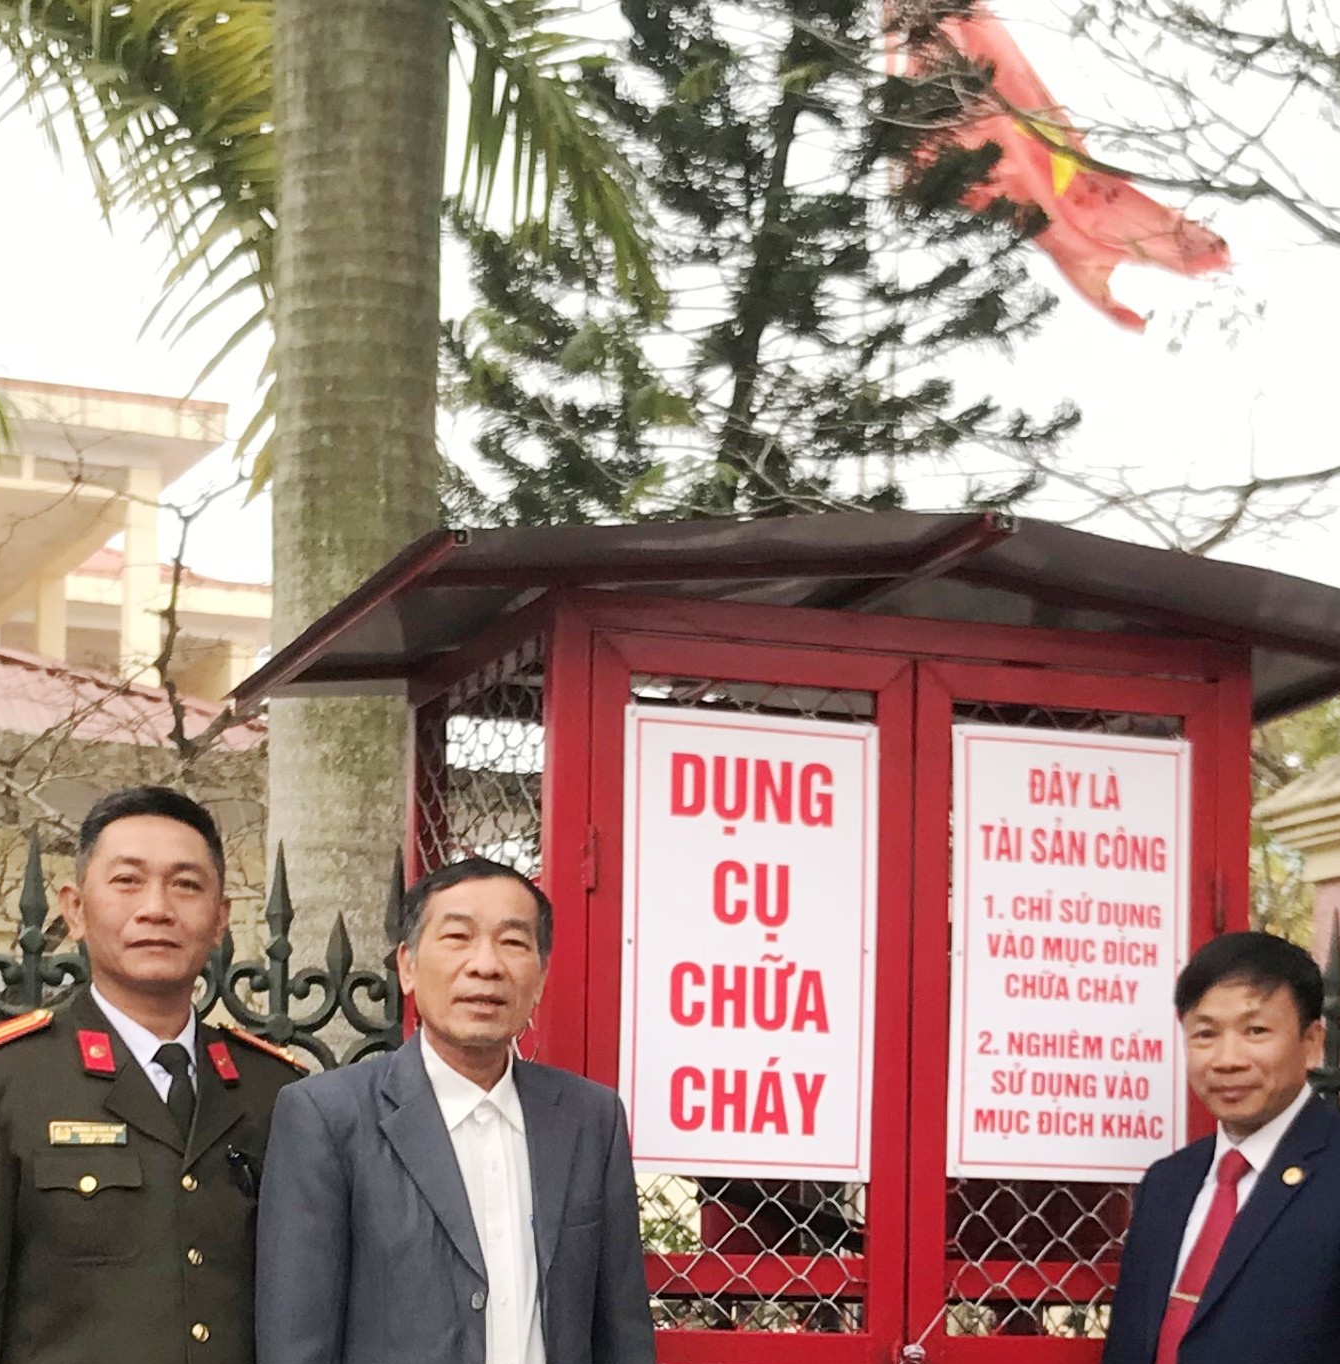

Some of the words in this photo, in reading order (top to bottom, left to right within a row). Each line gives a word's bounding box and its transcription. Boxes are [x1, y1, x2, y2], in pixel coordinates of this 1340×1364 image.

[670, 751, 835, 836] DỤNG
[1028, 762, 1082, 807] ĐÂY
[1088, 767, 1122, 811] LÀ
[980, 817, 1023, 862] TÀI
[1031, 816, 1087, 866] SẢN
[1094, 826, 1167, 873] CÔNG
[712, 859, 790, 943] CỤ
[983, 895, 1005, 920] 1.
[1012, 889, 1053, 921] CHỈ
[1059, 891, 1093, 925] SỬ
[1097, 902, 1162, 933] DỤNG
[987, 929, 1035, 960] VÀO
[1042, 937, 1096, 968] MỤC
[1102, 935, 1158, 967] ĐÍCH
[669, 952, 831, 1034] CHỮA
[1005, 970, 1070, 1000] CHỮA
[1077, 974, 1139, 1005] CHÁY
[977, 1030, 1000, 1056] 2.
[1007, 1029, 1103, 1060] NGHIÊM
[1110, 1029, 1163, 1062] CẤM
[669, 1056, 828, 1136] CHÁY
[991, 1062, 1027, 1095] SỬ
[1031, 1071, 1097, 1103] DỤNG
[1104, 1070, 1150, 1101] VÀO
[974, 1108, 1030, 1140] MỤC
[1036, 1105, 1094, 1137] ĐÍCH
[1101, 1109, 1164, 1141] KHÁC
